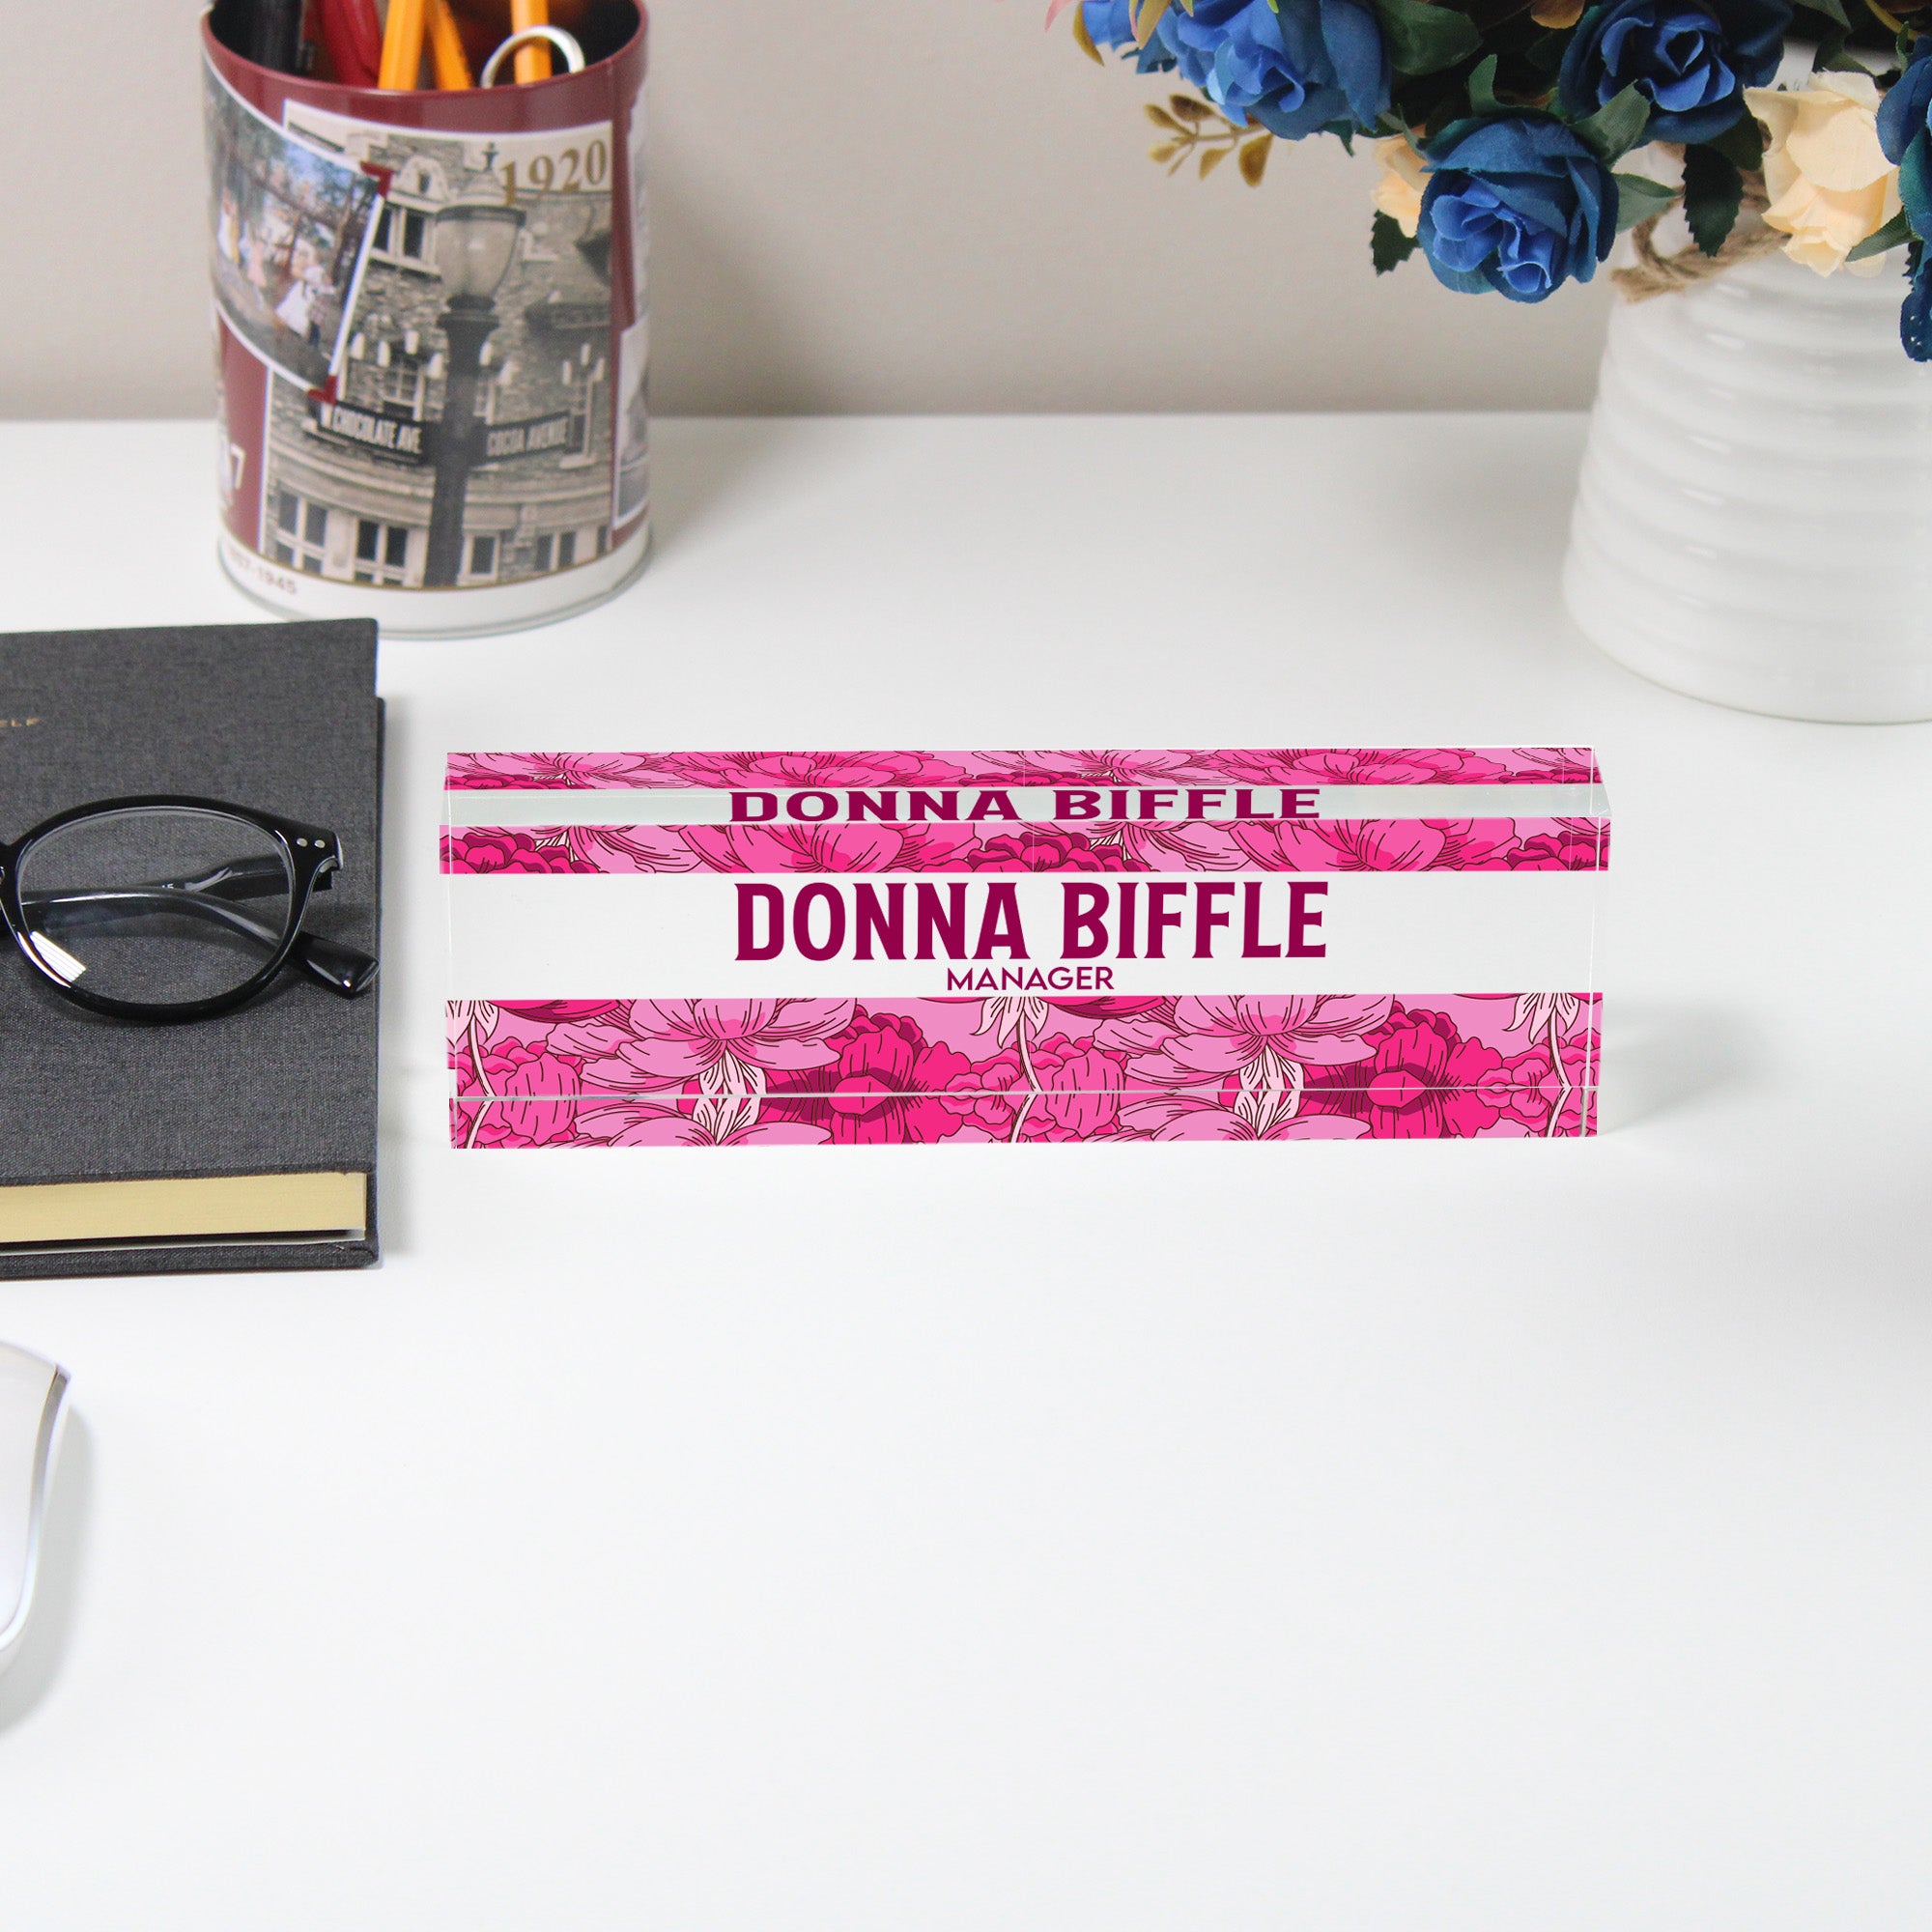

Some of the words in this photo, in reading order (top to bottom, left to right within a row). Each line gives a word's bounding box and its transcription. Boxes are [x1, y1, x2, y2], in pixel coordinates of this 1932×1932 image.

[501, 139, 607, 207] 1920
[729, 790, 1022, 822] DONNA
[1053, 788, 1321, 820] BIFFLE
[735, 883, 1030, 961] DONNA
[1061, 881, 1328, 959] BIFFLE
[948, 966, 1114, 991] MANAGER
